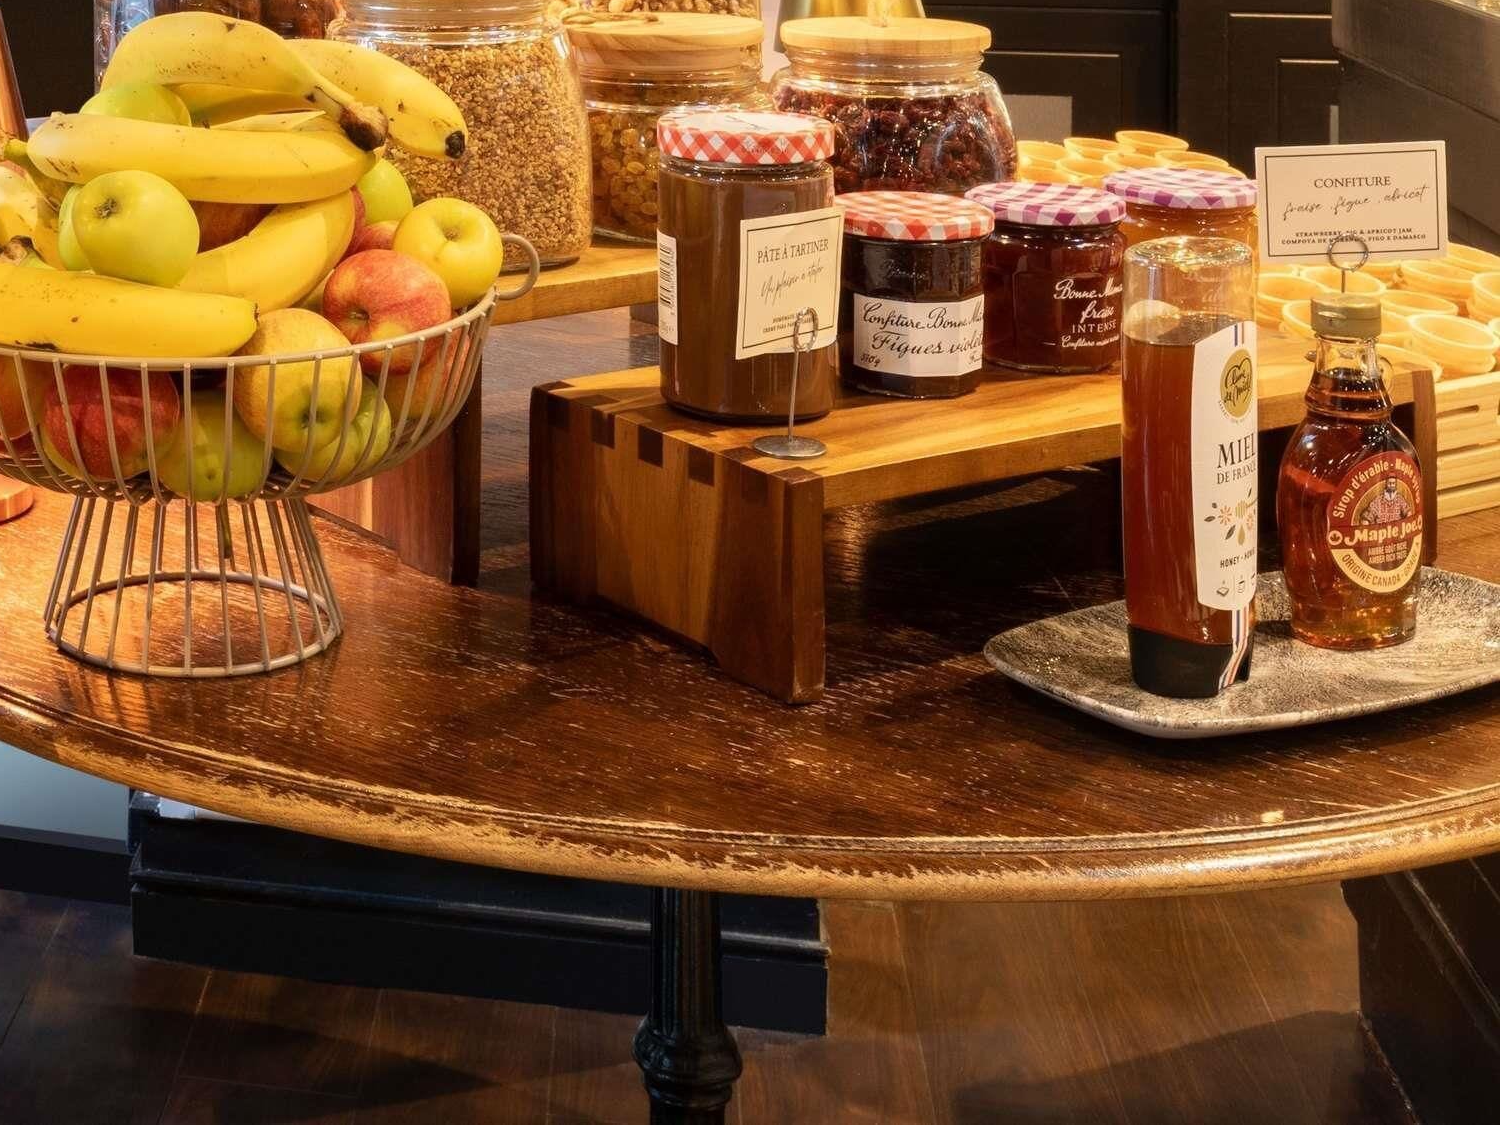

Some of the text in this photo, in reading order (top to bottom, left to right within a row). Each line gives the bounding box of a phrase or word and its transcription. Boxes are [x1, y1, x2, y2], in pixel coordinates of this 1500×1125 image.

[1314, 176, 1391, 189] CONFITURE
[757, 239, 828, 264] PÂTE À TARTINER
[863, 302, 925, 330] Confiture
[1072, 319, 1116, 333] INTENSE
[872, 331, 944, 358] Figues
[1217, 433, 1255, 469] MIEL
[1217, 471, 1229, 484] DE
[1333, 488, 1355, 518] Sirop
[1352, 461, 1389, 490] d'érable
[1344, 525, 1399, 546] Maple
[1400, 520, 1417, 539] Joe
[1220, 555, 1239, 568] HONEY
[1342, 554, 1372, 583] ORIGINE
[1372, 574, 1401, 587] CANADA
